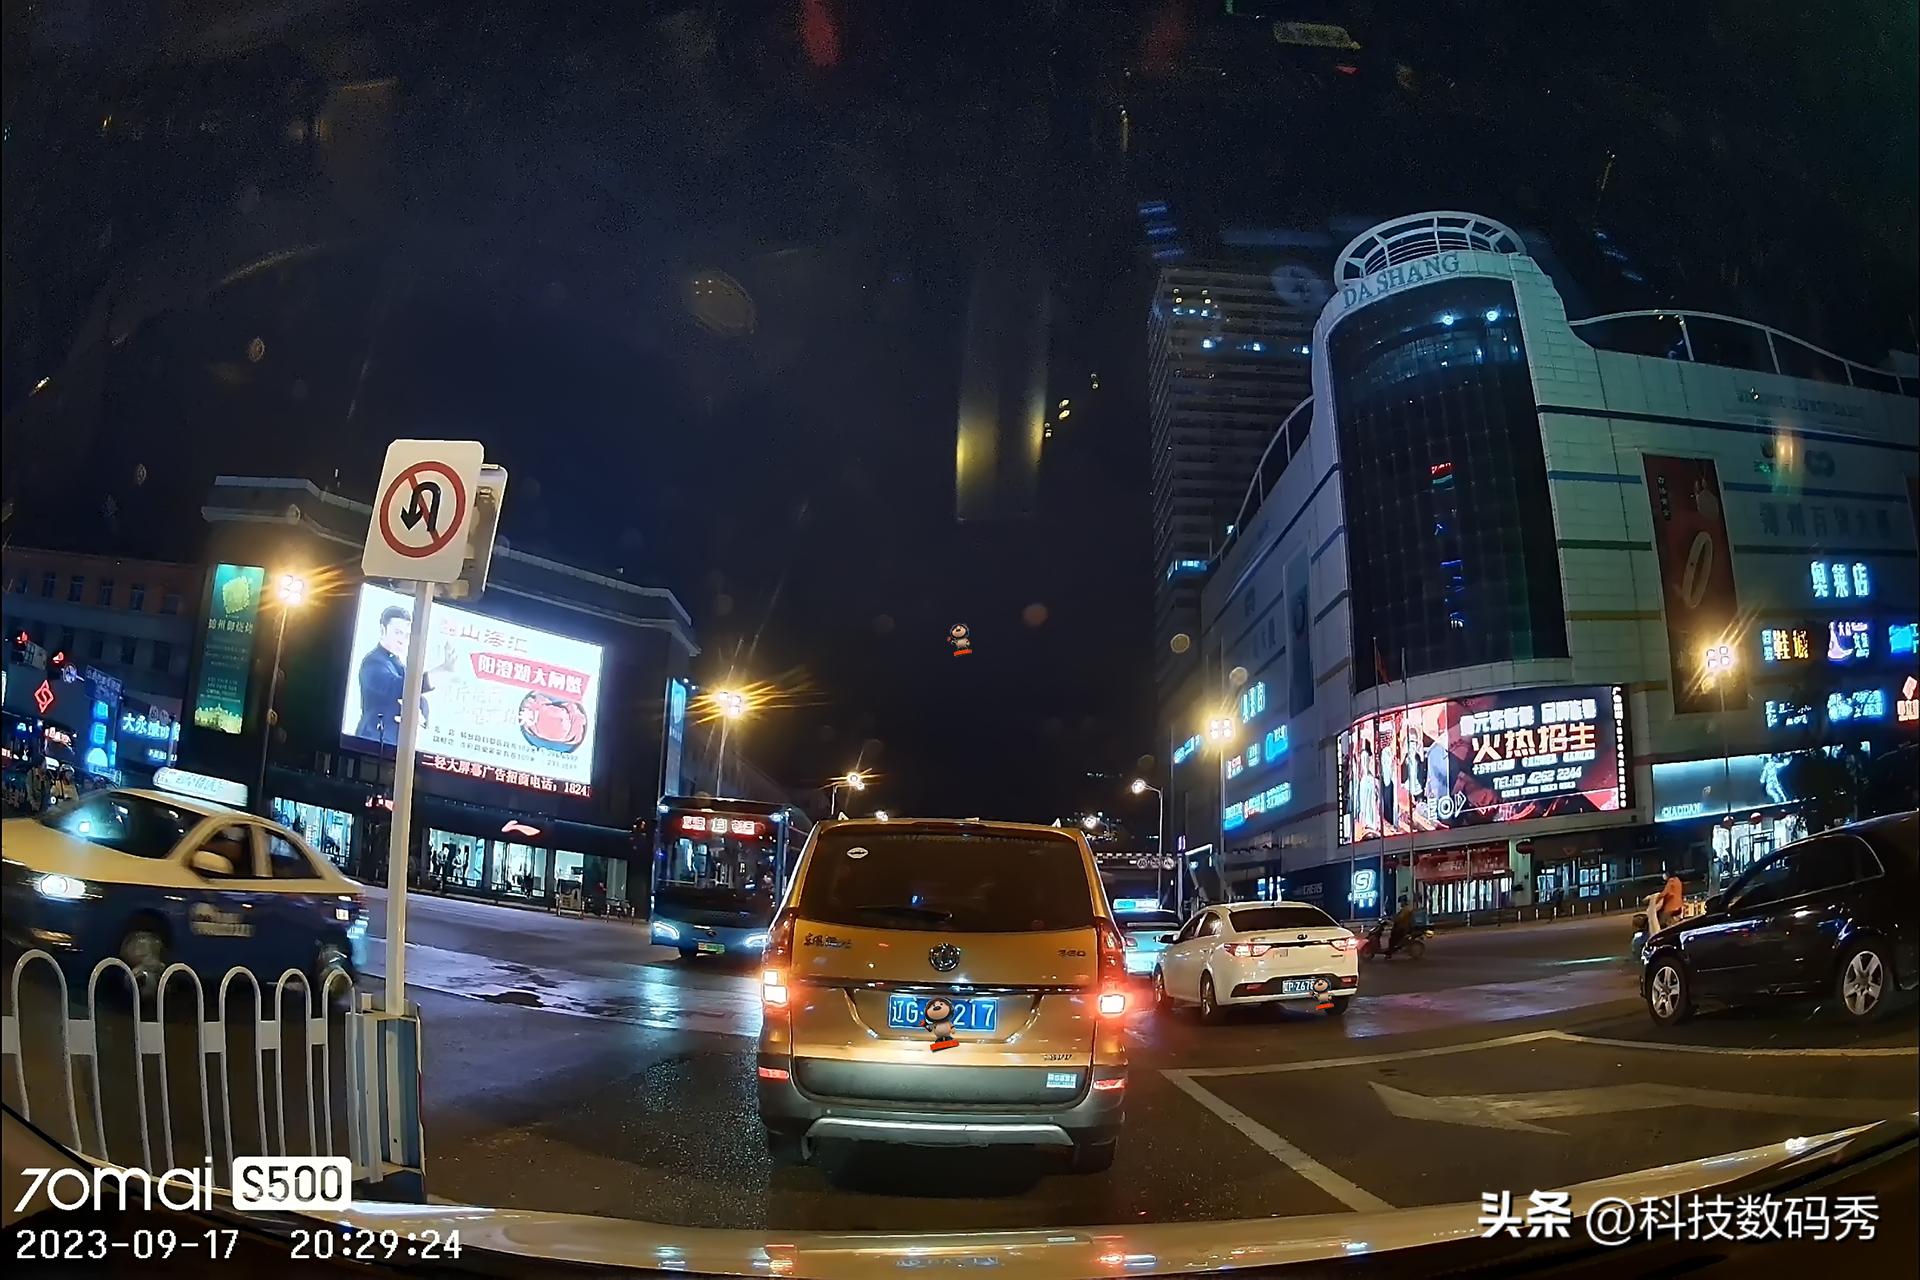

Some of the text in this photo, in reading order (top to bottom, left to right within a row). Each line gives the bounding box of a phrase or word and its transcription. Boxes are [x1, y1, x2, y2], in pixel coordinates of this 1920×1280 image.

[1342, 252, 1459, 308] DA SHANG
[478, 654, 584, 693] 阳澄湖大闸蟹
[1472, 722, 1596, 764] 火热招生
